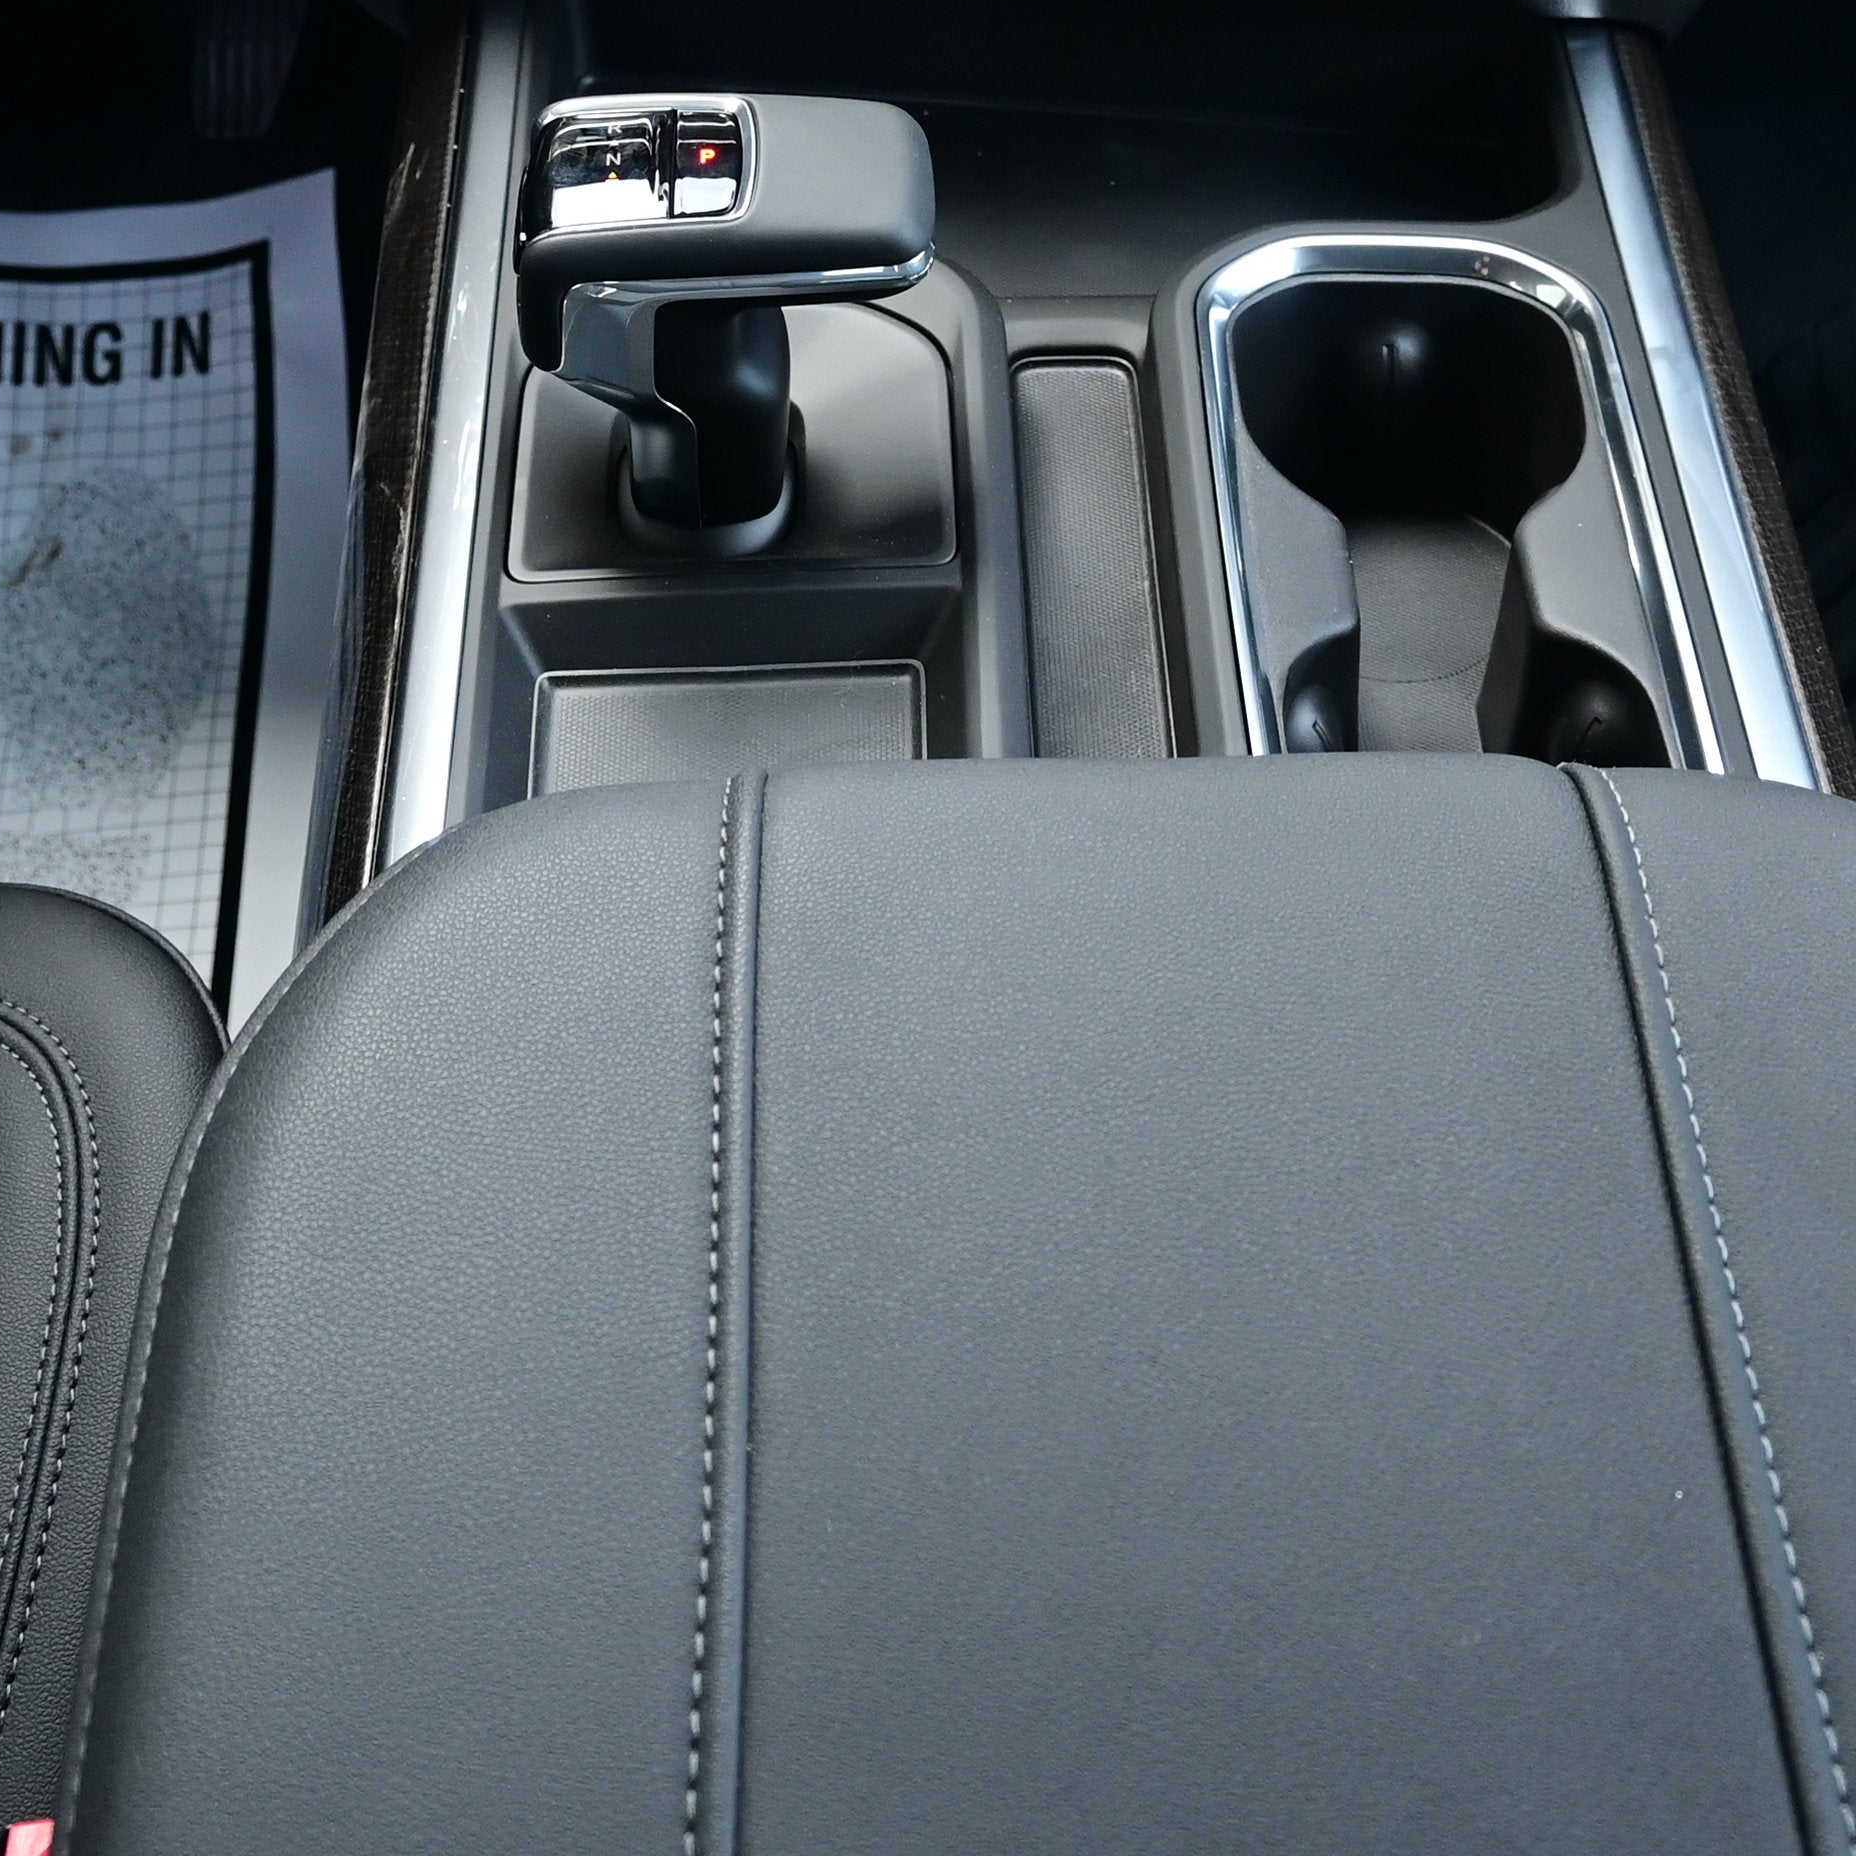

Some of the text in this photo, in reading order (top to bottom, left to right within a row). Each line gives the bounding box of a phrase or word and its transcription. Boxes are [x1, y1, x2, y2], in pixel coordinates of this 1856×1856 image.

[605, 152, 622, 167] N
[699, 147, 716, 165] P
[149, 310, 211, 380] IN
